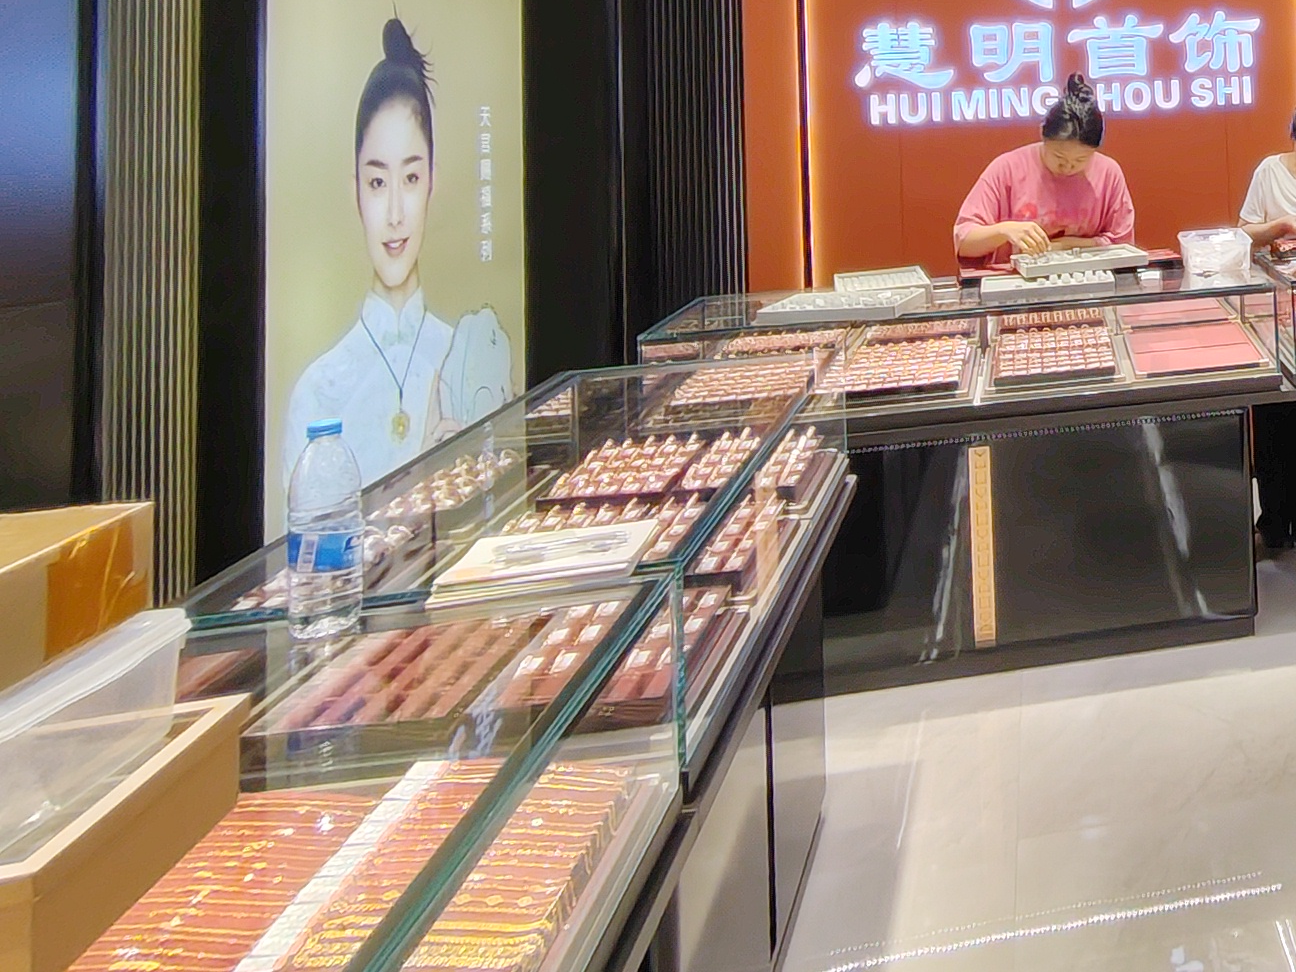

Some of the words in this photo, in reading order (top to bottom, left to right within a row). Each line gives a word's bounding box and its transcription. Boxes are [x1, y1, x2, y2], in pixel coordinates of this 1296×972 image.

[854, 11, 1261, 88] 慧明首饰
[868, 90, 944, 126] HUI
[951, 84, 1061, 122] MING
[1096, 78, 1182, 113] HOU
[1189, 75, 1253, 108] SHI
